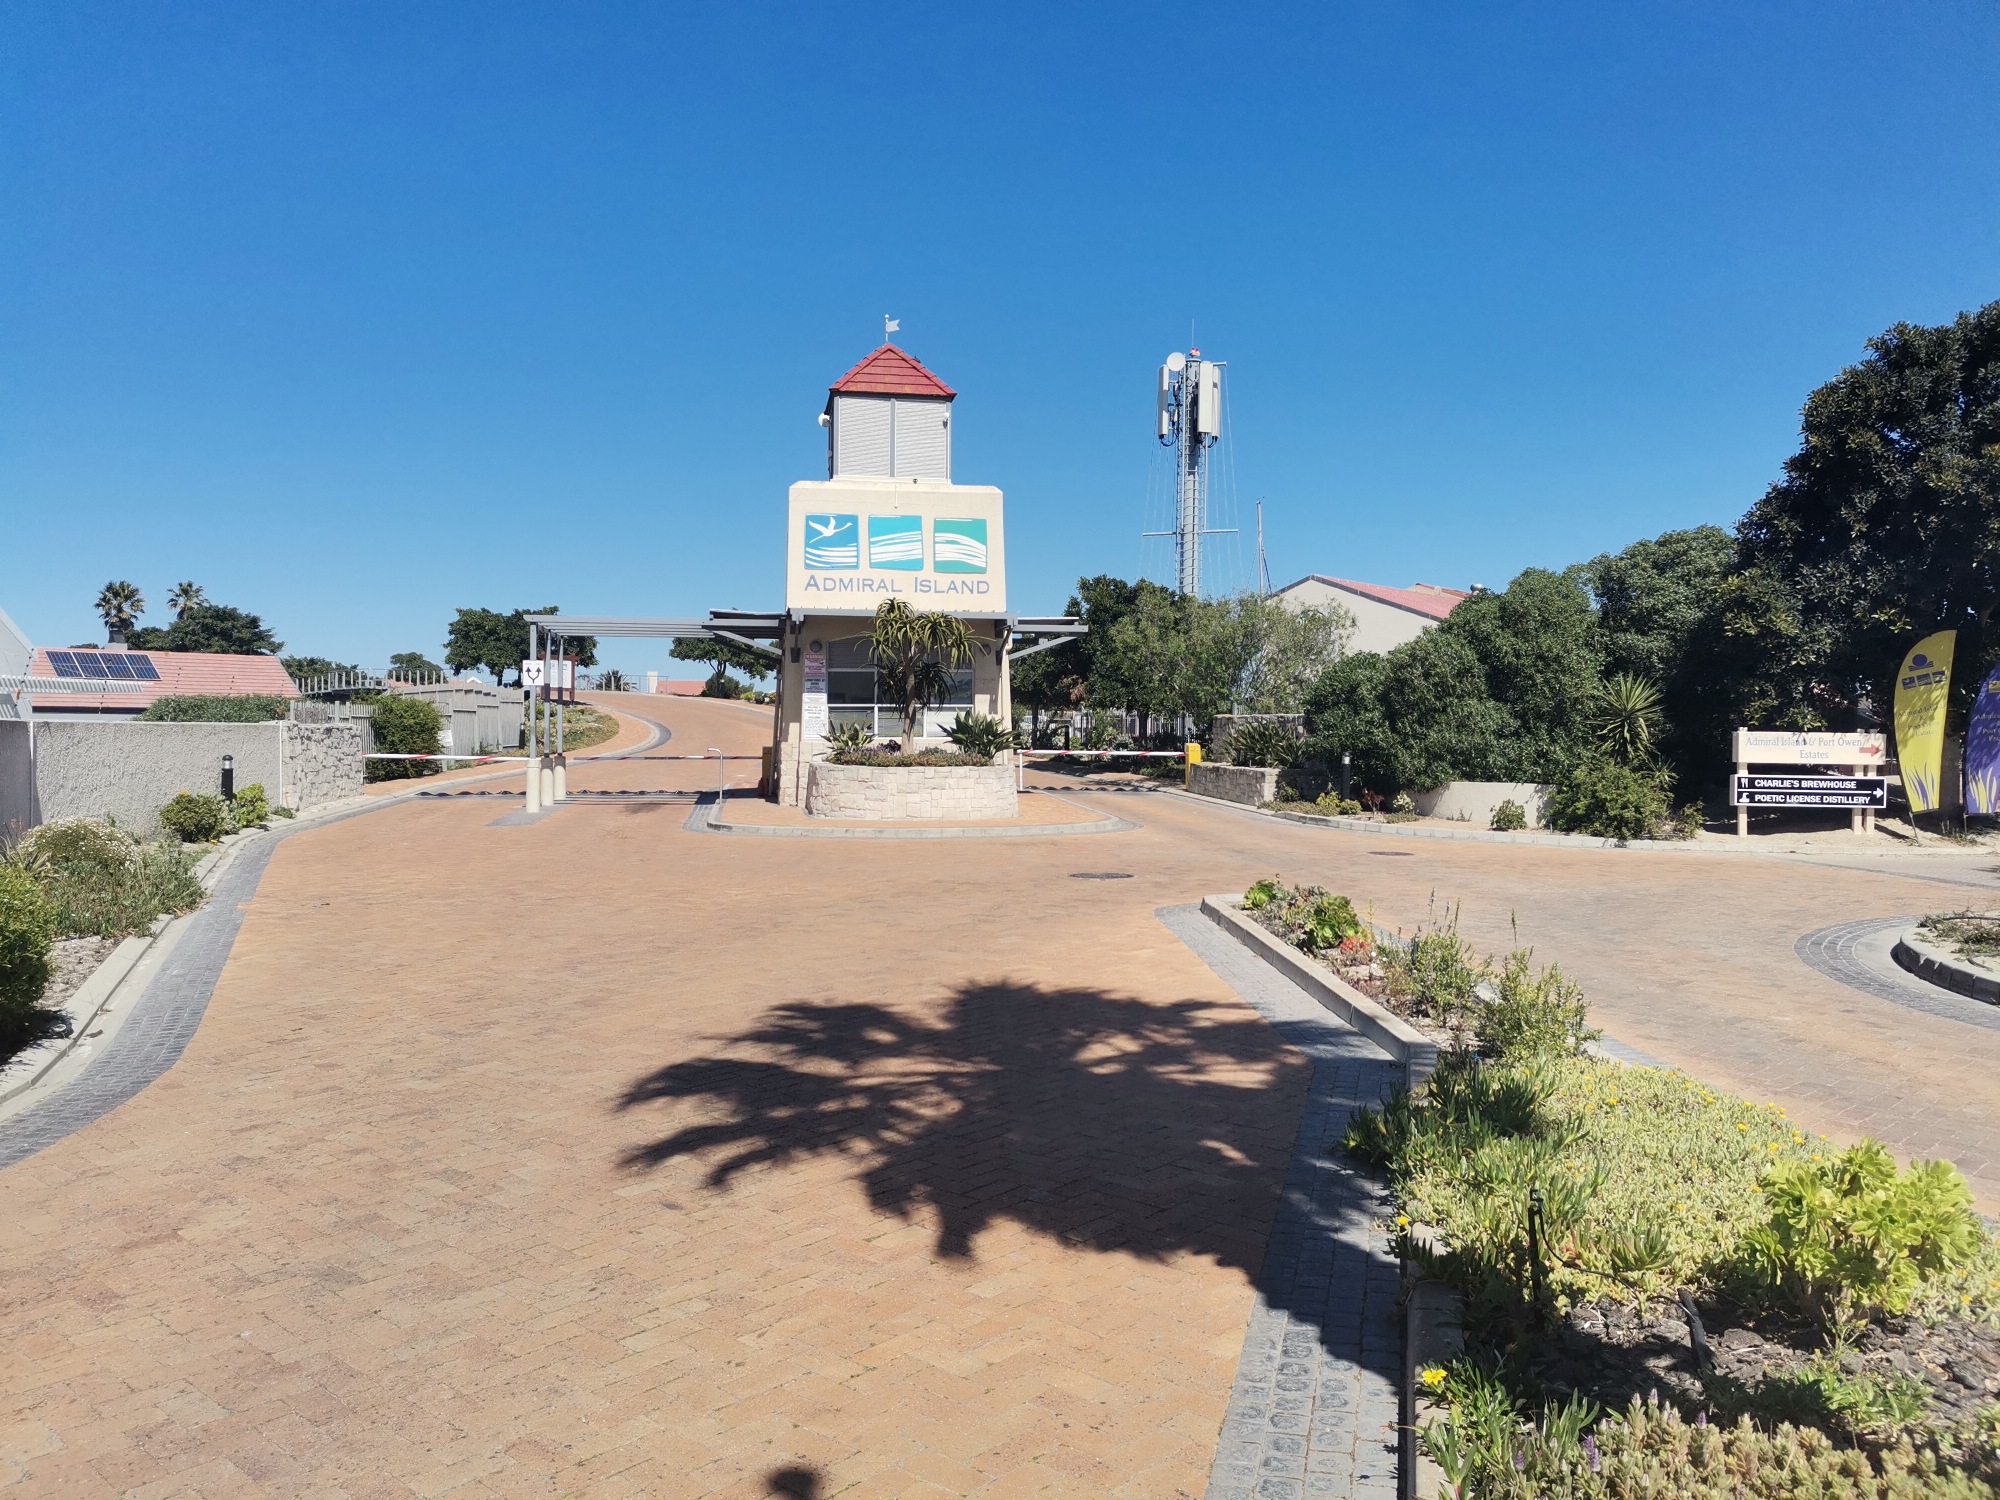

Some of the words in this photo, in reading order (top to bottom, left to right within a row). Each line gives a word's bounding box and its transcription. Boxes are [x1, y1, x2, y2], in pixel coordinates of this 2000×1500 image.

[804, 574, 903, 593] ADMIRAL
[914, 576, 990, 595] ISLAND
[1746, 736, 1779, 747] Admiral
[1818, 737, 1835, 747] Port
[1837, 738, 1862, 748] Owen
[1800, 749, 1829, 759] Estates
[1754, 779, 1799, 788] CHARLIE'S
[1801, 780, 1857, 789] BREWHOUSE
[1754, 794, 1785, 803] POETIC
[1786, 794, 1822, 804] LICENSE
[1823, 795, 1871, 804] DISTILLERY
